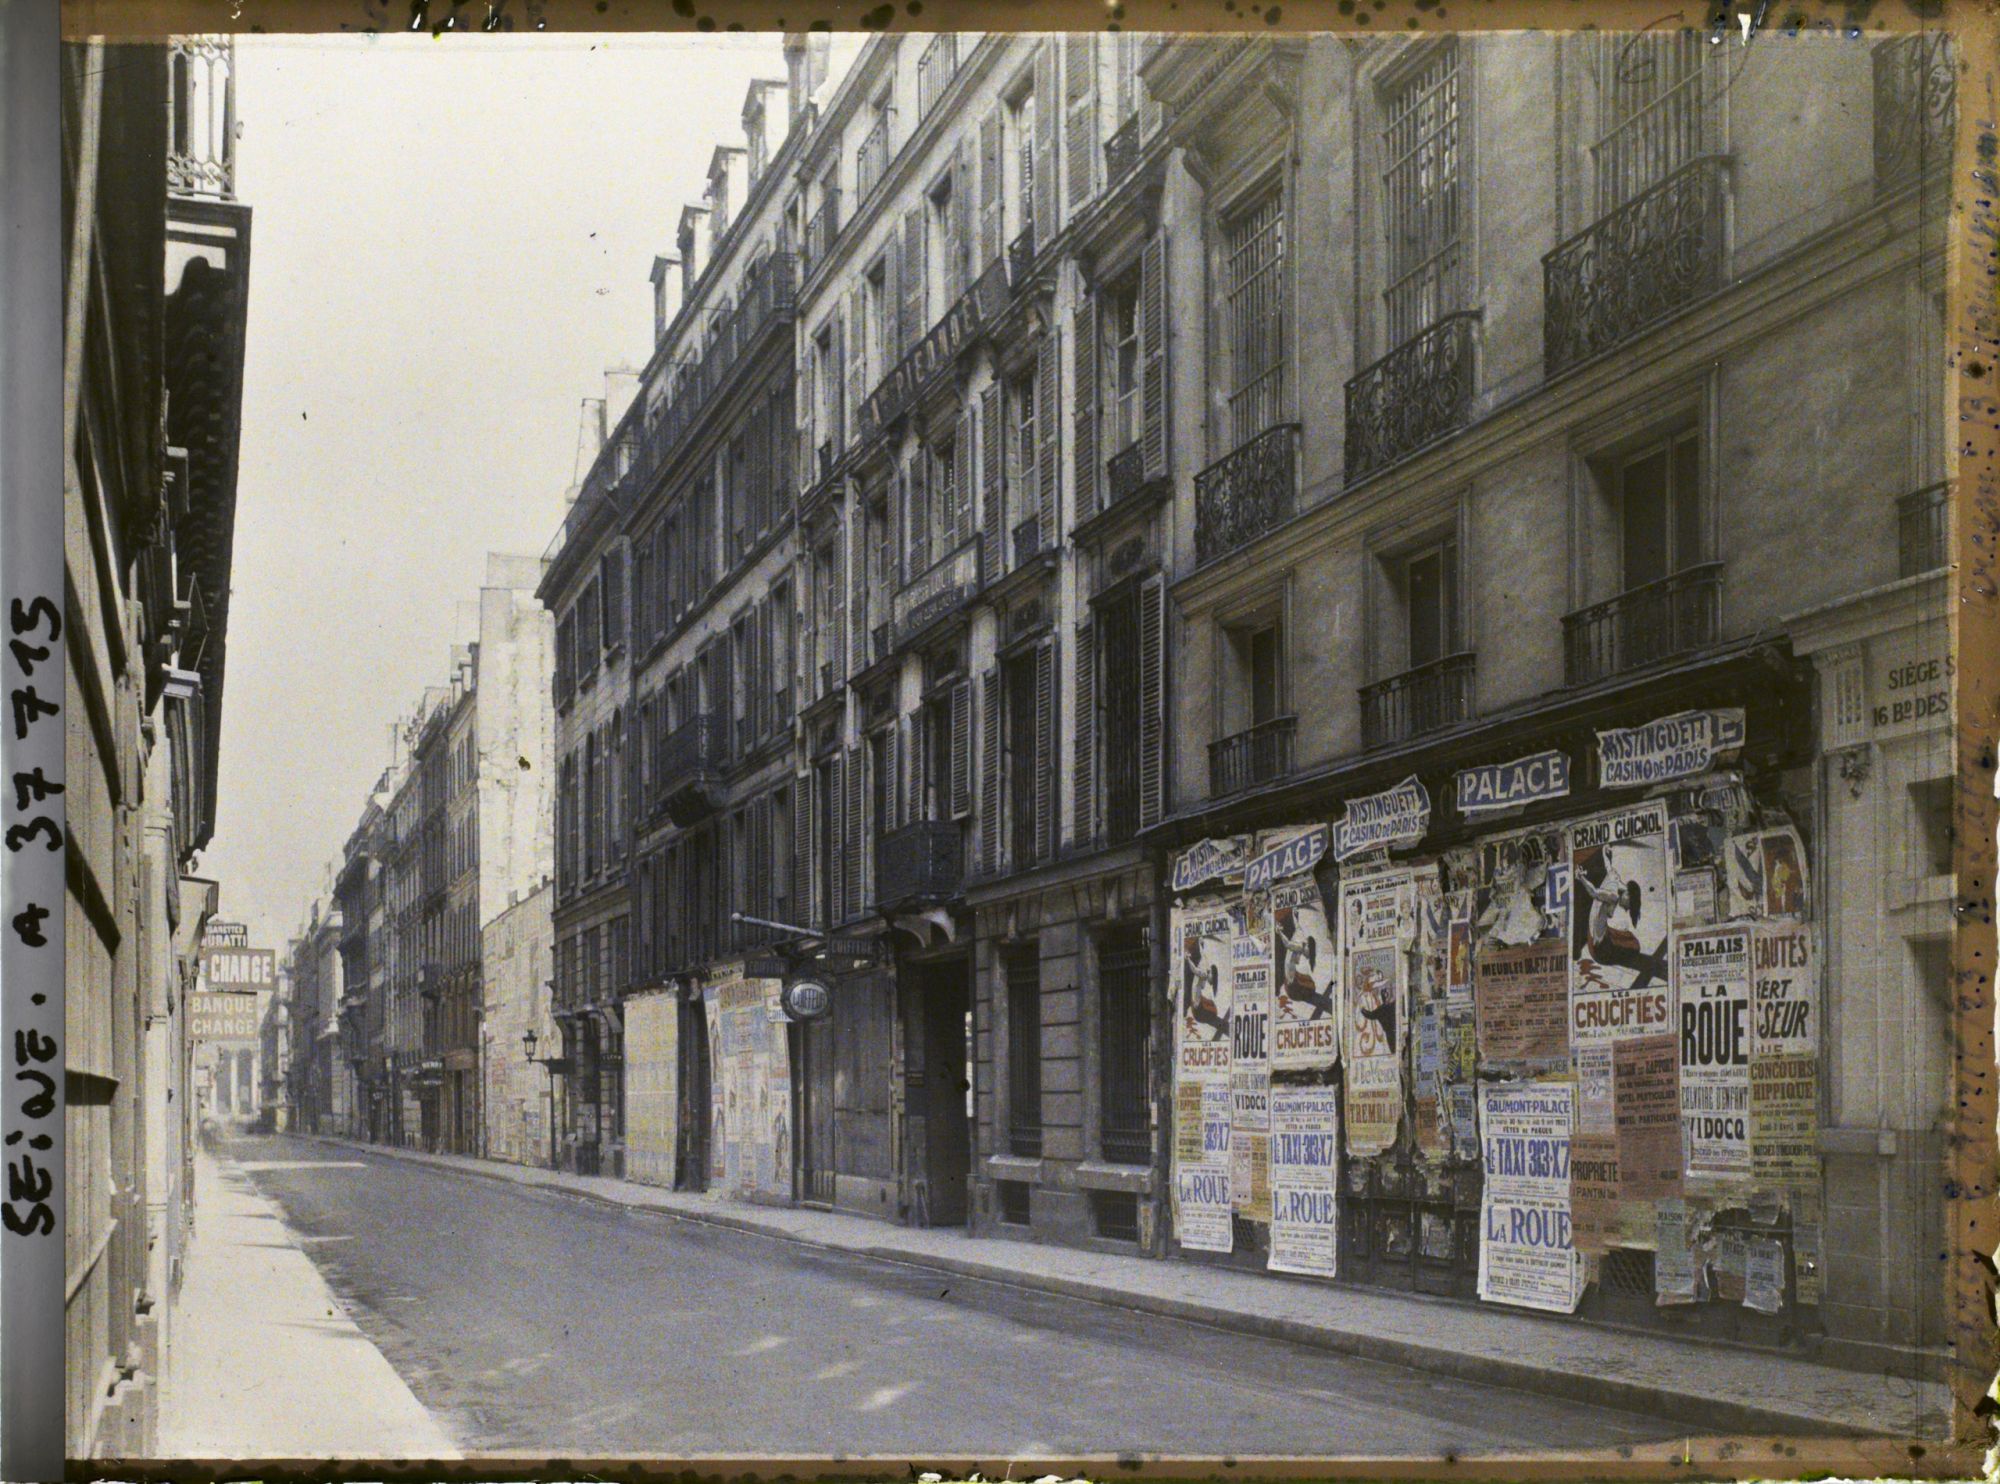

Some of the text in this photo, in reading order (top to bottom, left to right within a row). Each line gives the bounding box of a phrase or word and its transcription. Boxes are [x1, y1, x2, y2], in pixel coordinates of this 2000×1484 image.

[11, 595, 62, 740] 715
[1889, 660, 1940, 690] SIÈGE
[1873, 706, 1888, 727] 16
[1915, 691, 1949, 718] DES
[1602, 715, 1708, 762] MISTINGUETT
[1464, 758, 1564, 802] PALACE
[1606, 758, 1653, 783] CASINO
[1665, 747, 1708, 775] PARIS
[6, 766, 65, 853] 37
[1348, 789, 1417, 827] MISTINGUETT
[1349, 823, 1381, 845] CASINO
[1390, 814, 1418, 837] PARIS
[1574, 823, 1611, 850] GRAND
[1614, 812, 1664, 840] GUIGNOL
[1250, 832, 1324, 890] PALACE
[12, 902, 49, 947] A
[1184, 922, 1203, 938] GRAND
[1684, 937, 1744, 957] PALAIS
[211, 954, 272, 984] CHANGE
[1236, 971, 1267, 984] PALAIS
[1482, 960, 1523, 977] MEUBLES
[192, 997, 254, 1015] BANQUE
[1701, 985, 1728, 998] LA
[1244, 1003, 1258, 1012] LA
[192, 1018, 254, 1035] CHANGE
[1233, 1013, 1268, 1060] ROUE
[1681, 999, 1748, 1066] ROUE
[1751, 1059, 1814, 1081] CONCOURS
[1235, 1095, 1267, 1111] VIDOCQ
[1273, 1100, 1334, 1113] GAUMONT-PALACE
[1486, 1098, 1571, 1114] GAUMONT-PALACE
[1753, 1082, 1813, 1101] HIPPIQUE
[1281, 1134, 1301, 1165] TAXI
[1497, 1138, 1525, 1177] TAXI
[1193, 1176, 1230, 1205] ROUE
[1273, 1191, 1334, 1225] LA ROUE
[1487, 1205, 1572, 1250] LA ROUE
